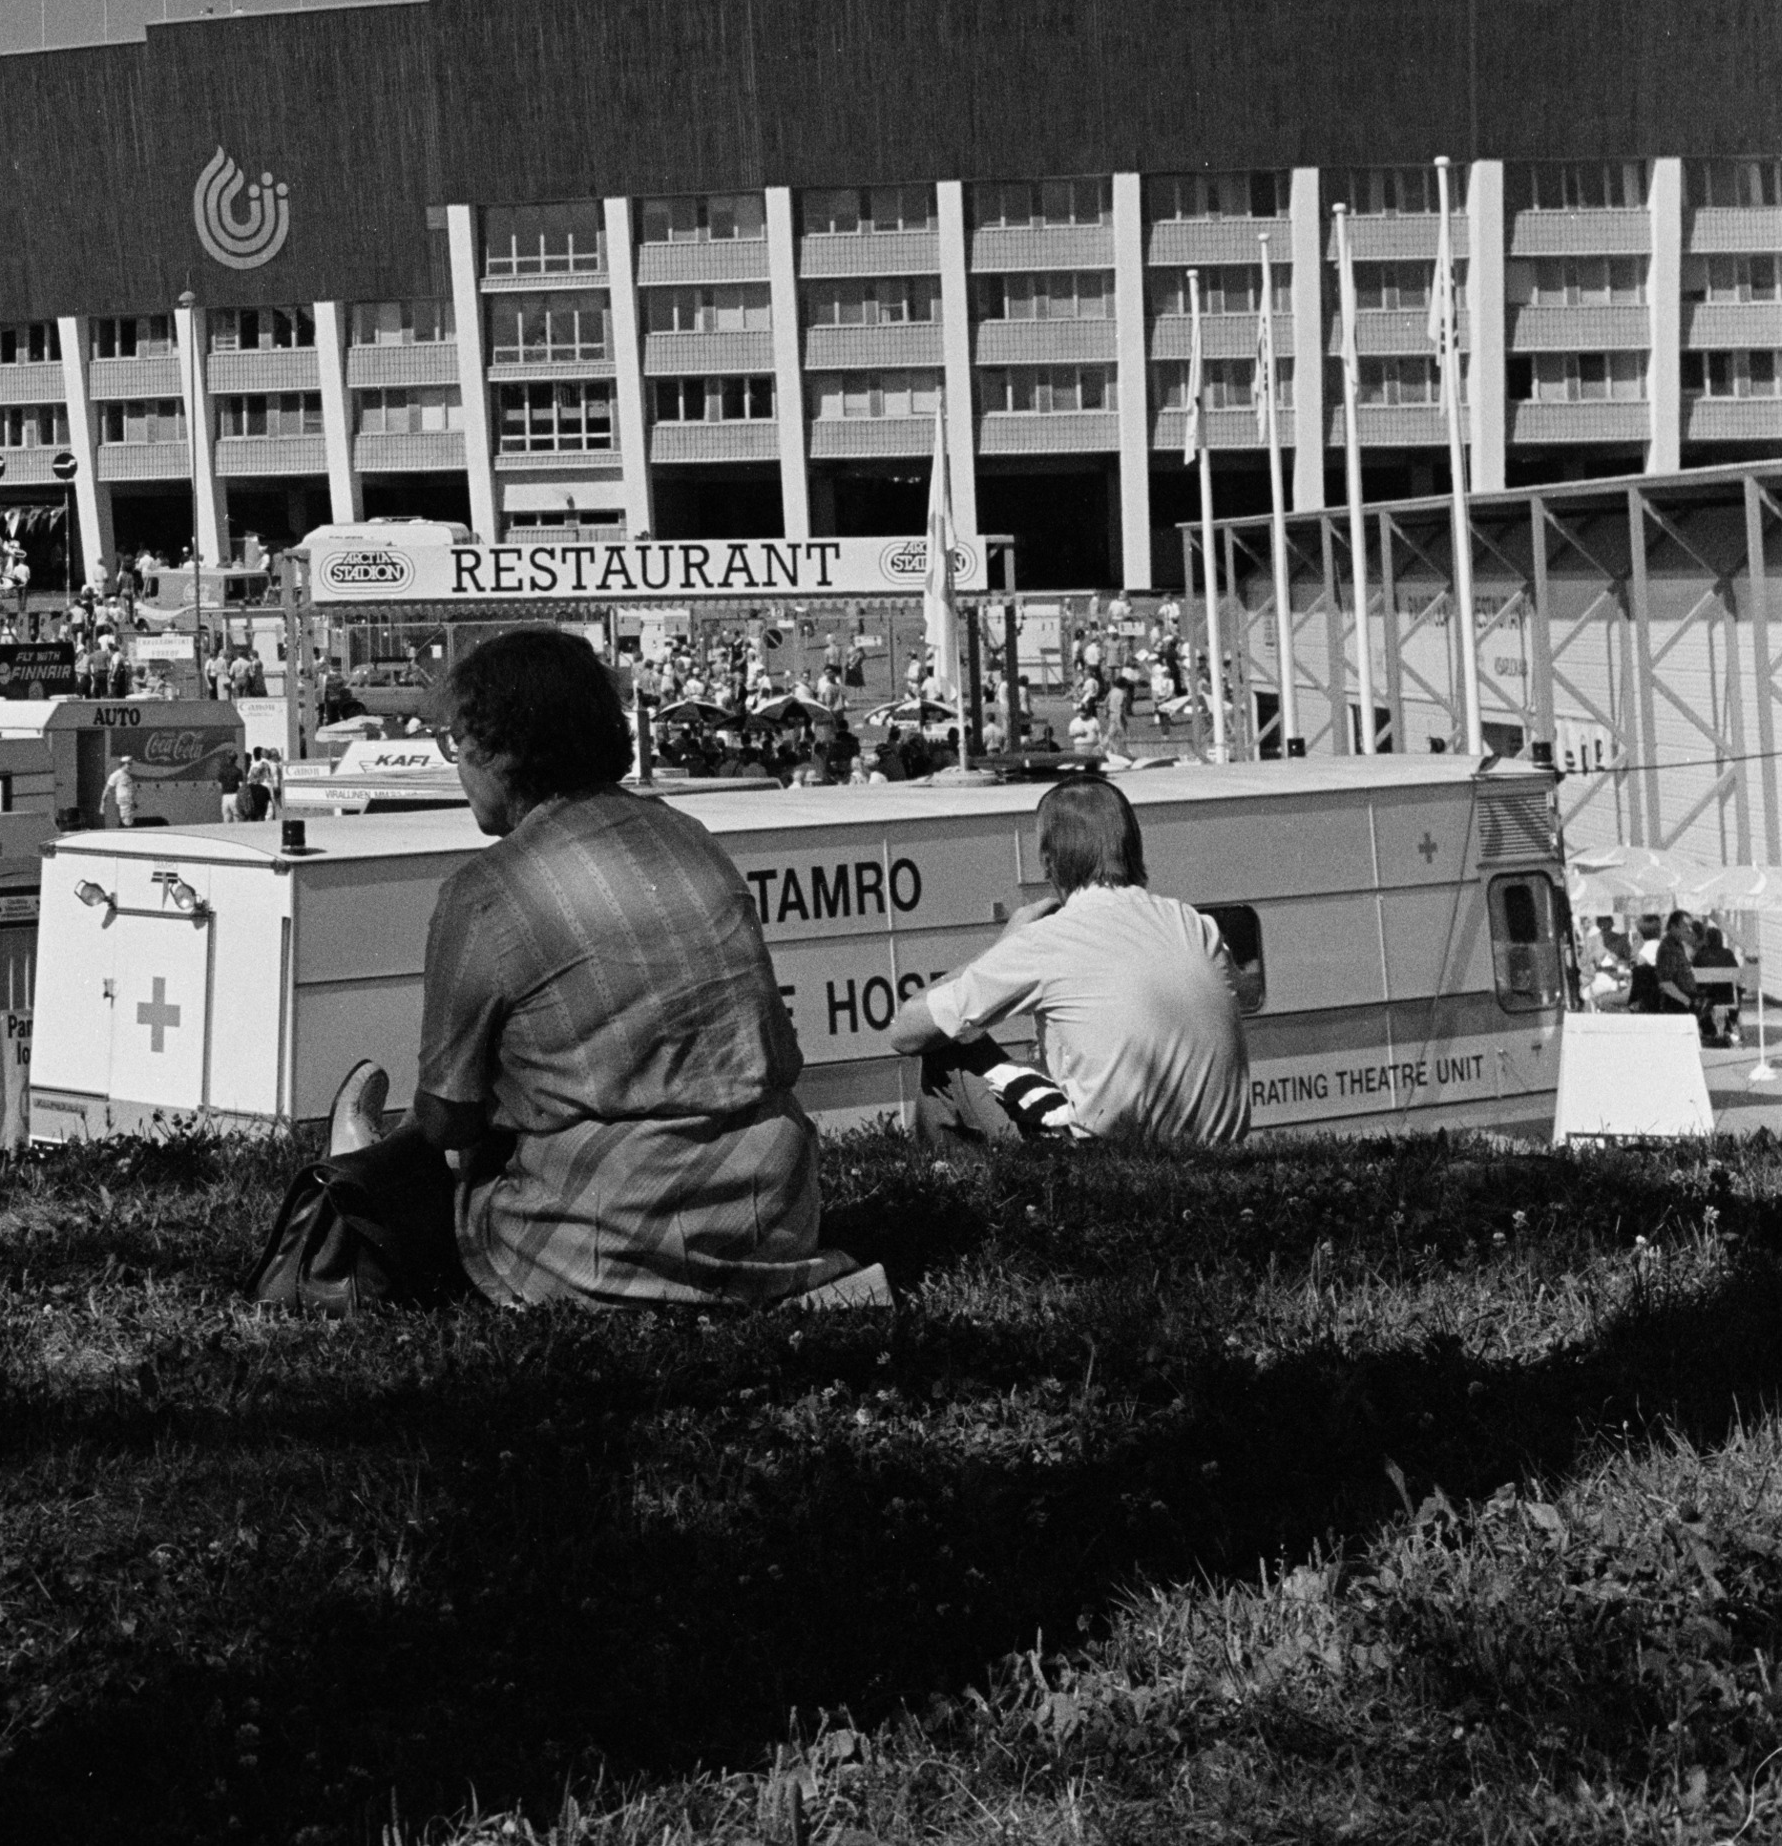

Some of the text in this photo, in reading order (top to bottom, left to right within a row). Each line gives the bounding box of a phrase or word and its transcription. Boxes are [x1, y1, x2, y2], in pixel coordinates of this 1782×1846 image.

[904, 541, 927, 553] ARC
[332, 564, 402, 581] STADION
[450, 542, 841, 593] RESTAURANT
[16, 650, 61, 662] FLY WITH
[11, 664, 72, 680] FINNAIR
[239, 701, 276, 712] Canon
[93, 707, 141, 727] AUTO
[374, 754, 431, 767] KAFI
[285, 764, 320, 777] Canon
[747, 858, 922, 924] TAMRO
[1252, 1054, 1484, 1107] RATING THEATRE UNIT
